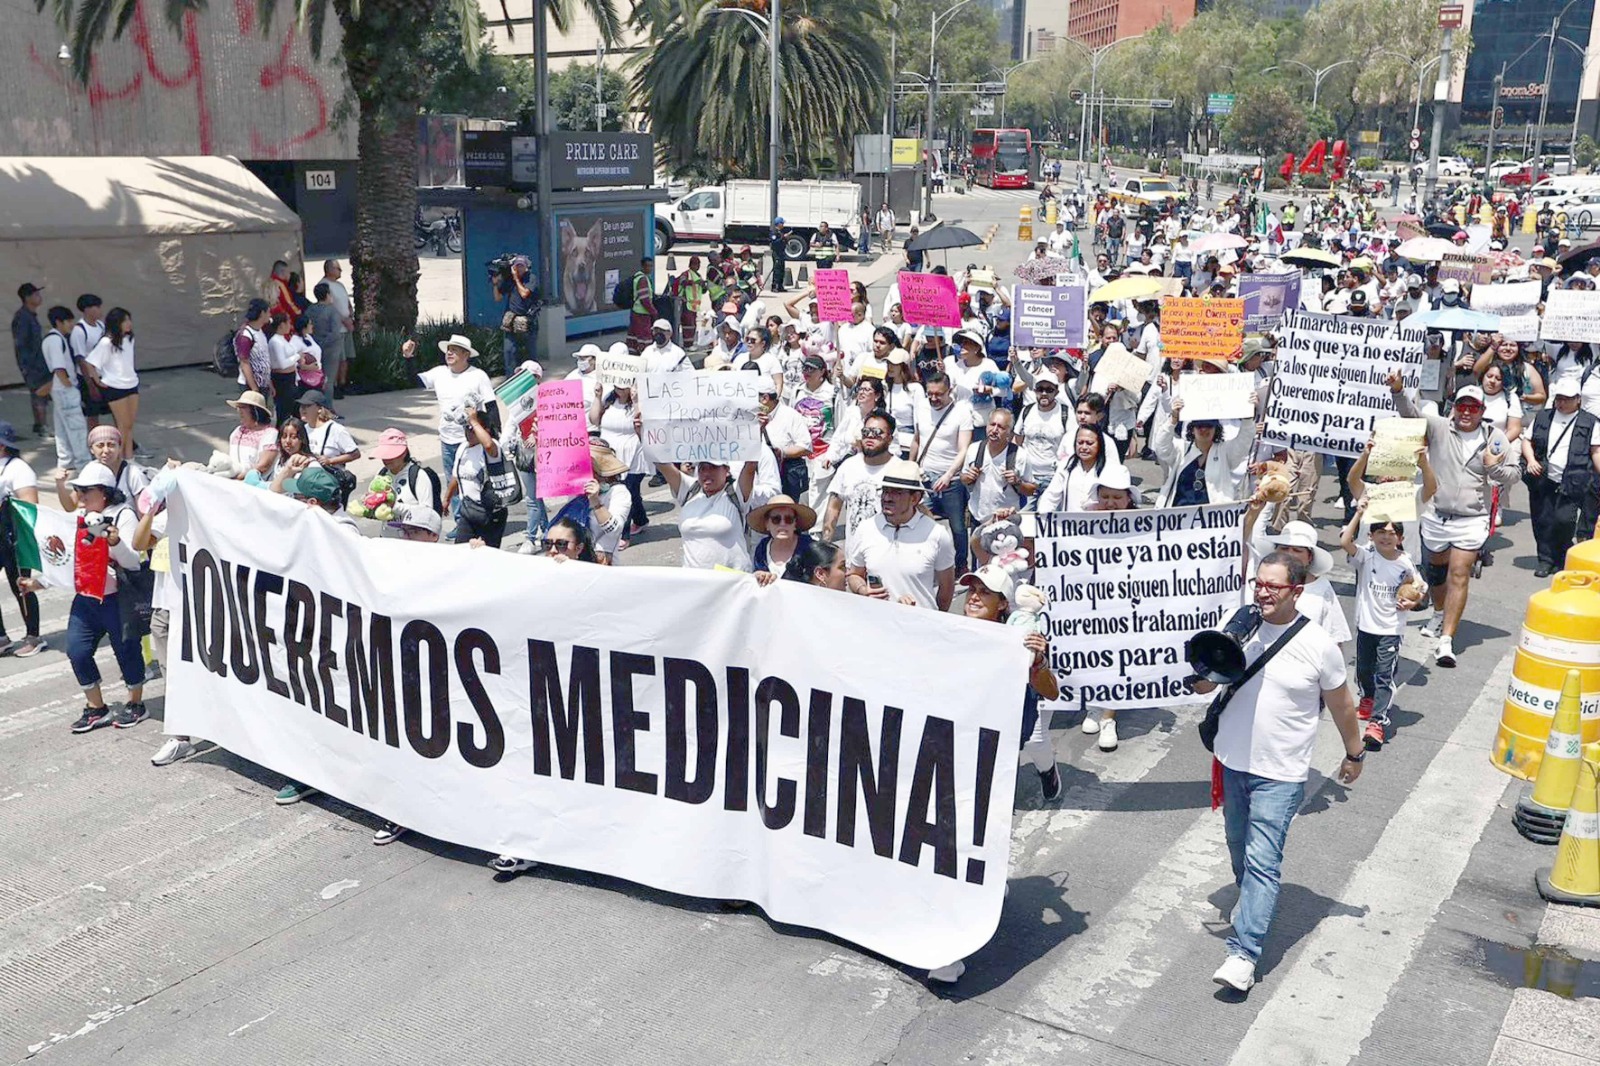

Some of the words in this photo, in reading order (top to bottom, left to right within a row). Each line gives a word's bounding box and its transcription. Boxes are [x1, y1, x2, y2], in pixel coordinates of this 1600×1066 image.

[566, 143, 605, 160] PRIME
[609, 143, 639, 160] CARE
[311, 174, 331, 187] 104
[604, 222, 611, 230] De
[612, 222, 620, 230] un
[1280, 309, 1299, 328] Mi
[1301, 315, 1347, 335] marcha
[1350, 323, 1364, 336] es
[1366, 325, 1389, 343] por
[1278, 336, 1287, 349] a
[1290, 331, 1310, 351] los
[1313, 339, 1339, 359] que
[1341, 343, 1360, 360] ya
[1363, 346, 1381, 359] no
[1384, 346, 1424, 365] están
[646, 378, 686, 400] LAS
[694, 375, 758, 398] FALSAS
[1284, 360, 1290, 373] a
[1292, 355, 1307, 376] los
[1309, 365, 1329, 383] que
[1331, 363, 1367, 386] siguen
[1369, 365, 1419, 389] lucndo
[1271, 377, 1335, 403] Queremos
[1266, 400, 1320, 426] dignos
[1321, 413, 1365, 433] para
[647, 429, 667, 446] NO
[676, 440, 742, 461] CANCER
[1262, 423, 1287, 441] los
[1290, 433, 1366, 453] paciente
[1035, 512, 1058, 539] Mi
[1061, 513, 1130, 537] marcha
[1134, 515, 1153, 532] es
[1156, 512, 1188, 541] por
[1190, 506, 1247, 530] Amor
[1035, 551, 1047, 568] a
[1052, 541, 1082, 567] los
[1086, 548, 1123, 574] que
[1128, 544, 1153, 570] ya
[1158, 543, 1183, 562] no
[1187, 535, 1242, 559] están
[1048, 584, 1057, 602] a
[1061, 574, 1083, 601] los
[1086, 581, 1114, 610] que
[1118, 574, 1169, 606] siguen
[1172, 565, 1242, 597] luchando
[1039, 611, 1129, 642] Queremos
[1047, 645, 1114, 679] ignos
[1119, 645, 1178, 677] para
[1080, 675, 1195, 711] pacientes
[1579, 699, 1600, 715] ici
[178, 543, 505, 769] ¡QUEREMOS
[527, 638, 1001, 886] MEDICINA!
